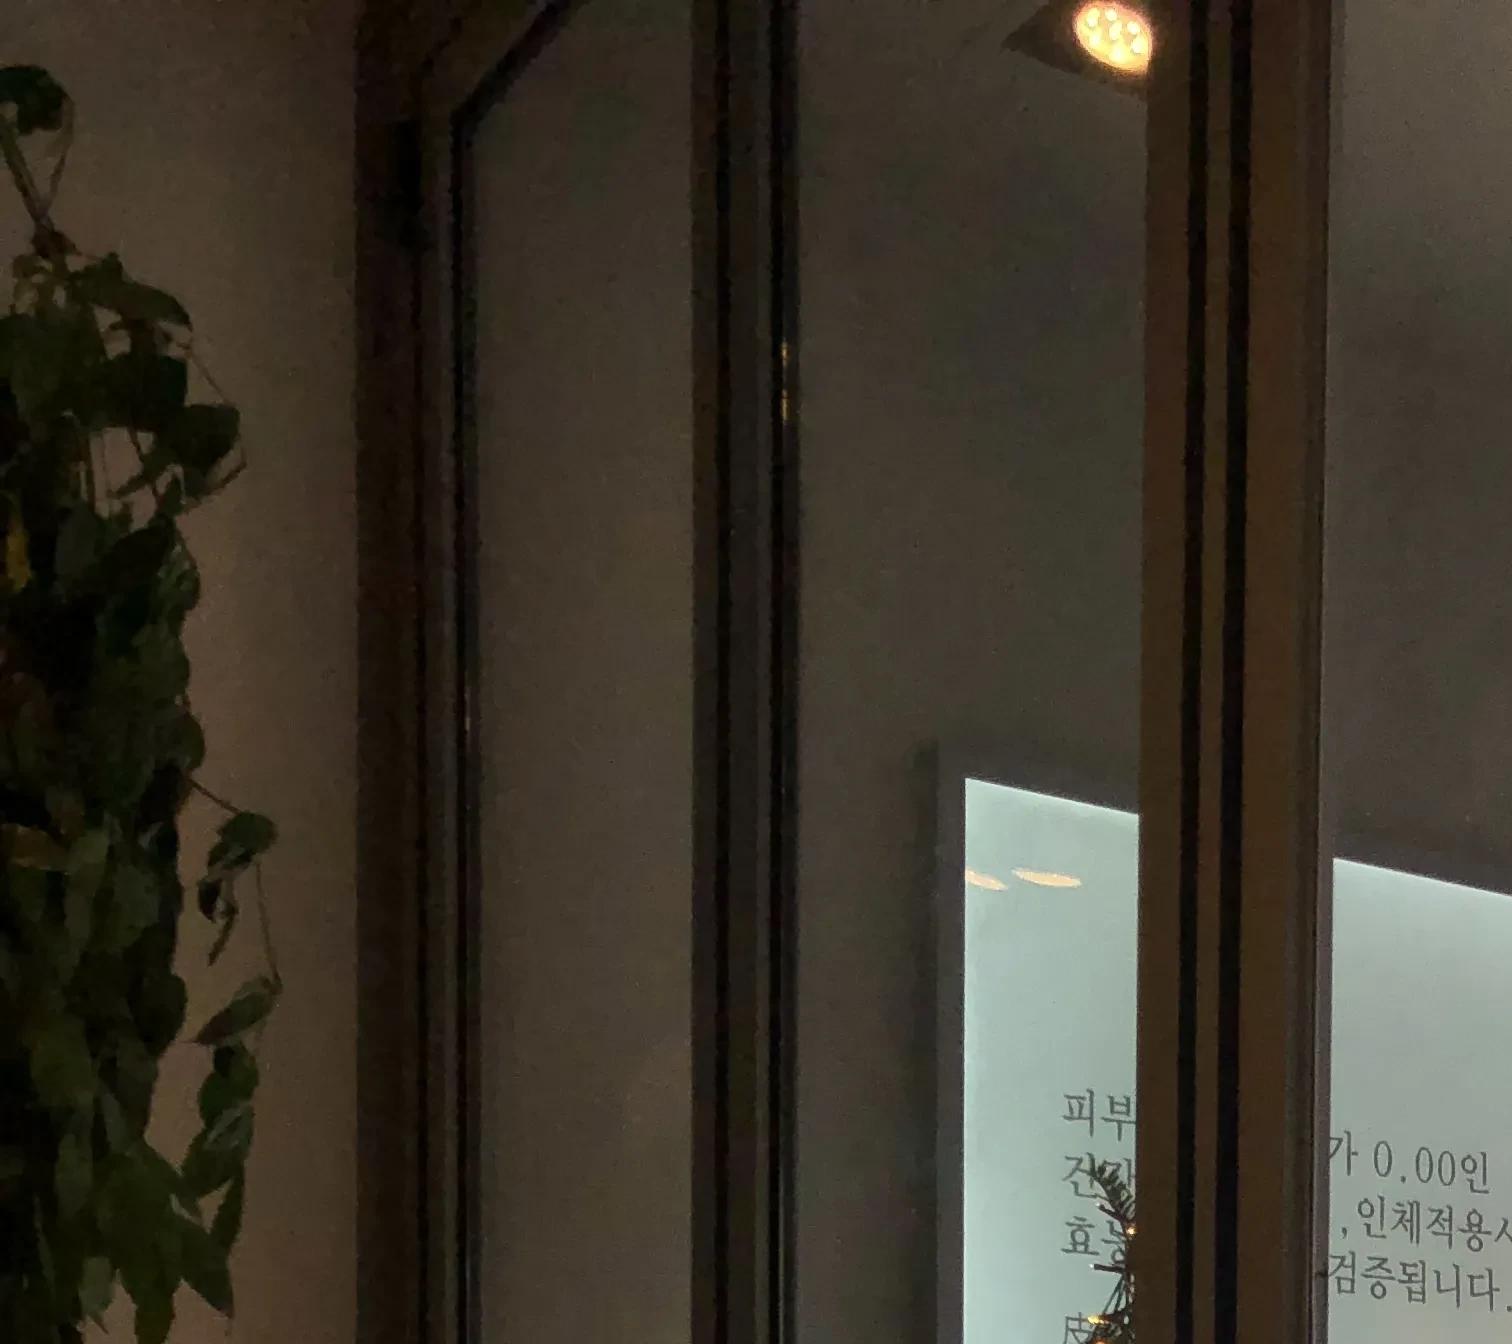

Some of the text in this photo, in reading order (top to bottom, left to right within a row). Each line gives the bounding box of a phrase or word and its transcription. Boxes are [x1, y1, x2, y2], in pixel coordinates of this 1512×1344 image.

[1062, 1088, 1136, 1142] 피부
[1373, 1140, 1490, 1194] 0.00인
[1328, 1251, 1512, 1312] 검증됩니다.
